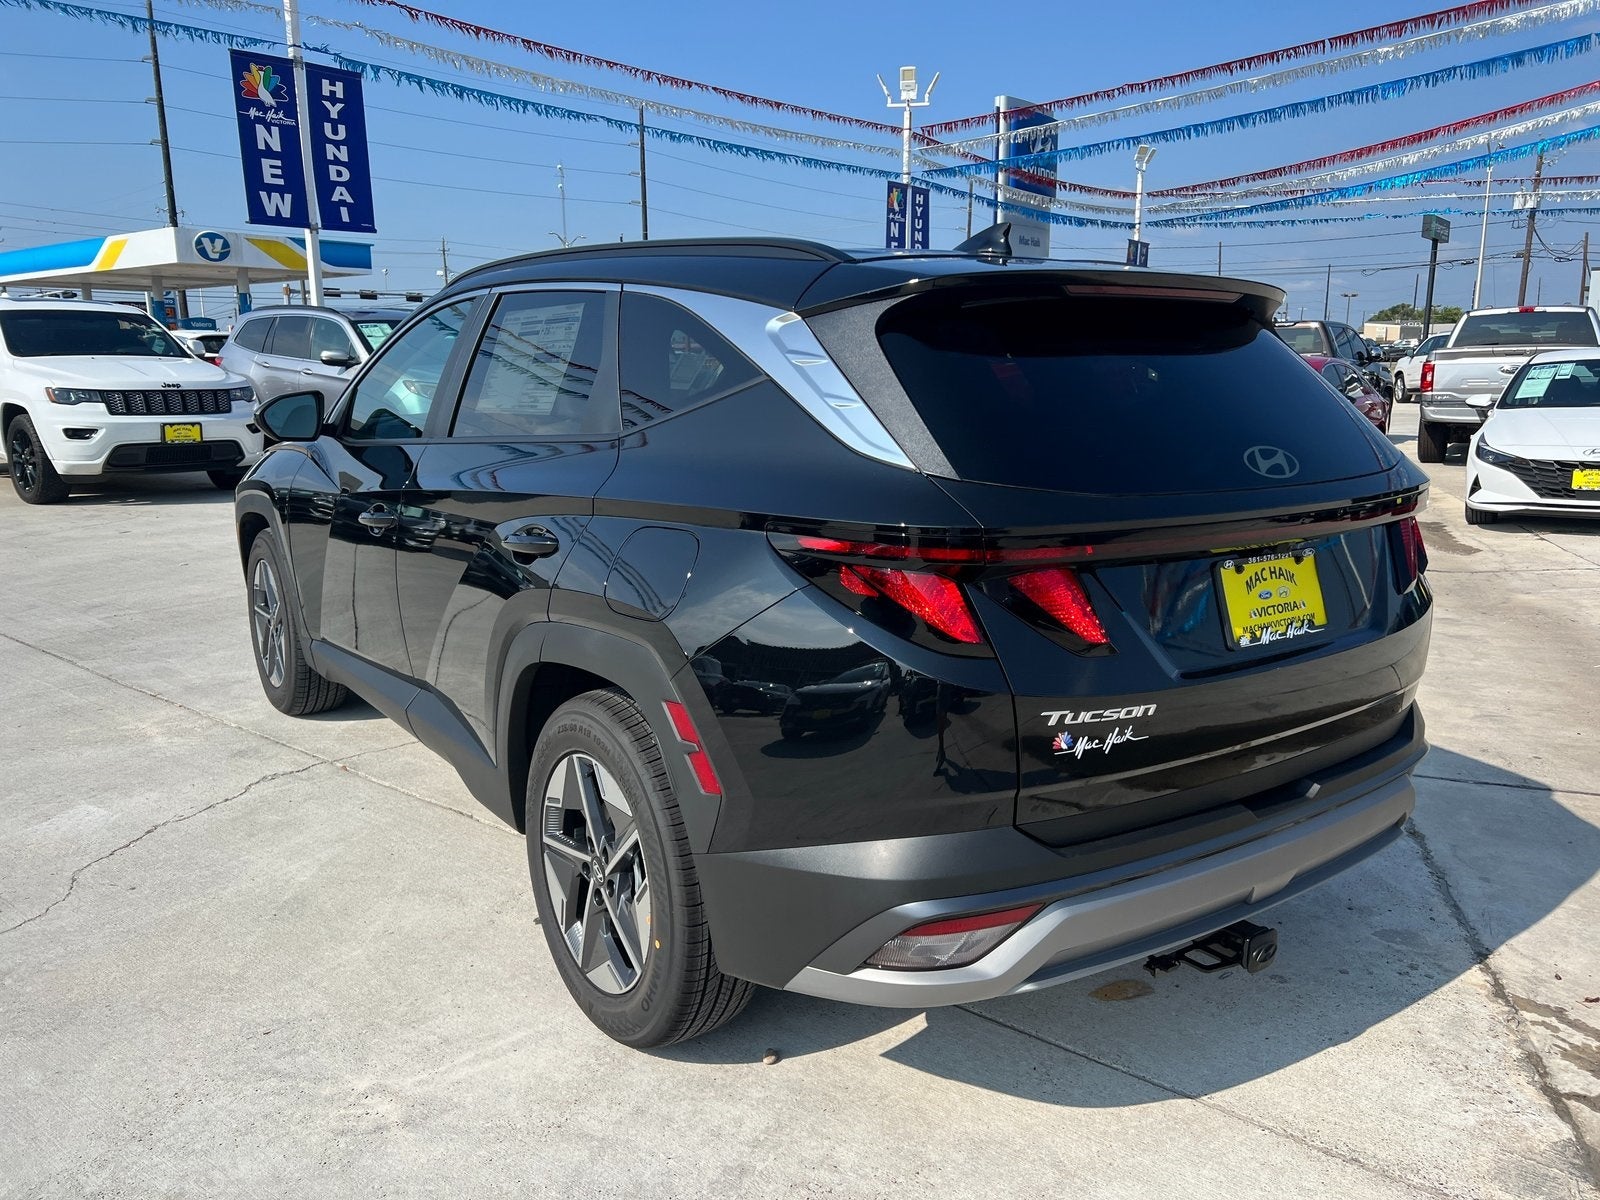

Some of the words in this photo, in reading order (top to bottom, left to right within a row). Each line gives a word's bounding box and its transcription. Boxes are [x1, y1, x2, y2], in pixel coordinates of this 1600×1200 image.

[321, 78, 355, 223] HYUNDAI
[255, 124, 292, 218] NEW
[1245, 567, 1268, 595] MAC
[1269, 566, 1298, 586] HAIK
[1255, 600, 1300, 618] VICTORIA
[1241, 627, 1287, 648] Mac
[1286, 620, 1325, 639] Haik
[1054, 735, 1103, 760] Mac
[1103, 725, 1149, 755] Haik
